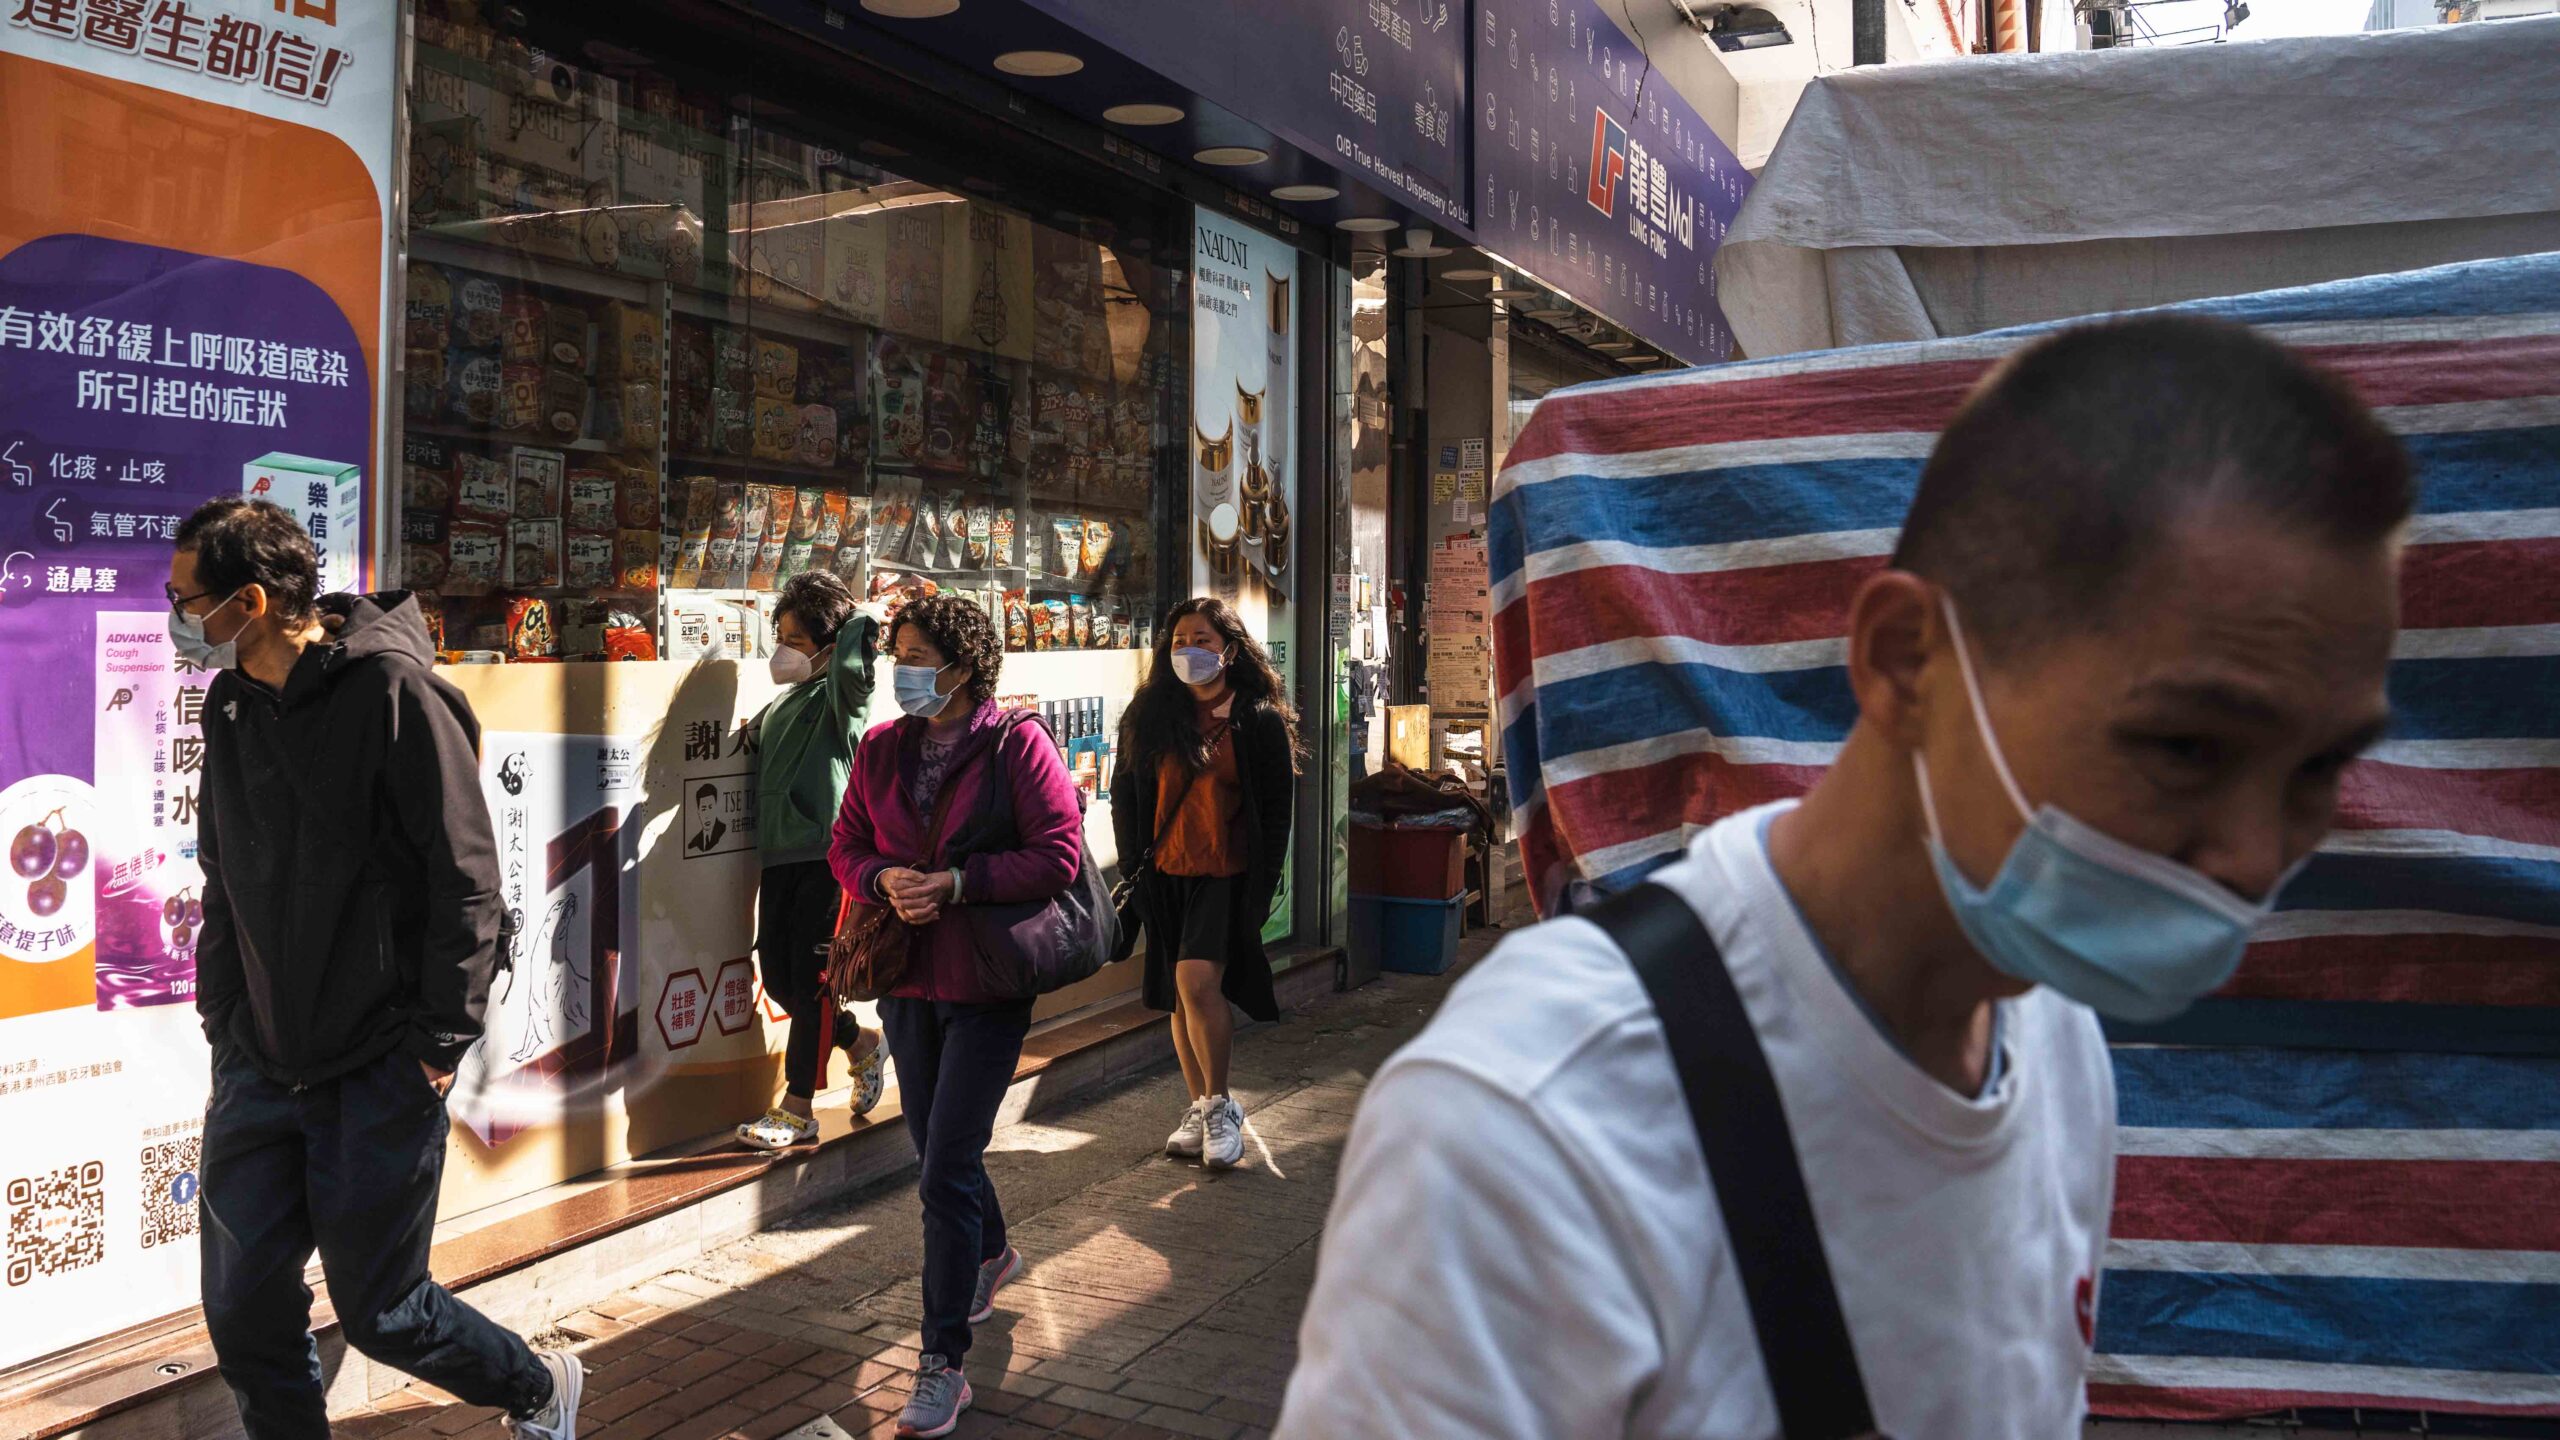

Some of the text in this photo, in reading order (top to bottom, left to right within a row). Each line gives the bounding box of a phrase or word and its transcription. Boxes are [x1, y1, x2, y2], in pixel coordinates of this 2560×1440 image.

[1330, 70, 1377, 126] 中西藥品
[1414, 102, 1436, 141] 零食
[1336, 134, 1469, 225] O/B True Harvest Dispensary Co Ltd
[1198, 226, 1248, 270] NAUNI
[1629, 213, 1667, 259] LUNG FUNG
[0, 305, 349, 387] 有效紓緩上呼吸道感染
[77, 369, 287, 428] 所引起的症狀
[46, 566, 118, 593] 通鼻塞
[106, 633, 163, 643] ADVANCE
[106, 648, 139, 660] Cough
[105, 662, 165, 674] Suspension
[723, 790, 742, 813] TSE
[170, 981, 189, 995] 120
[671, 989, 696, 1011] 壯腰
[724, 977, 748, 1000] 增強
[724, 997, 748, 1018] 體力
[671, 1008, 696, 1032] 補腎
